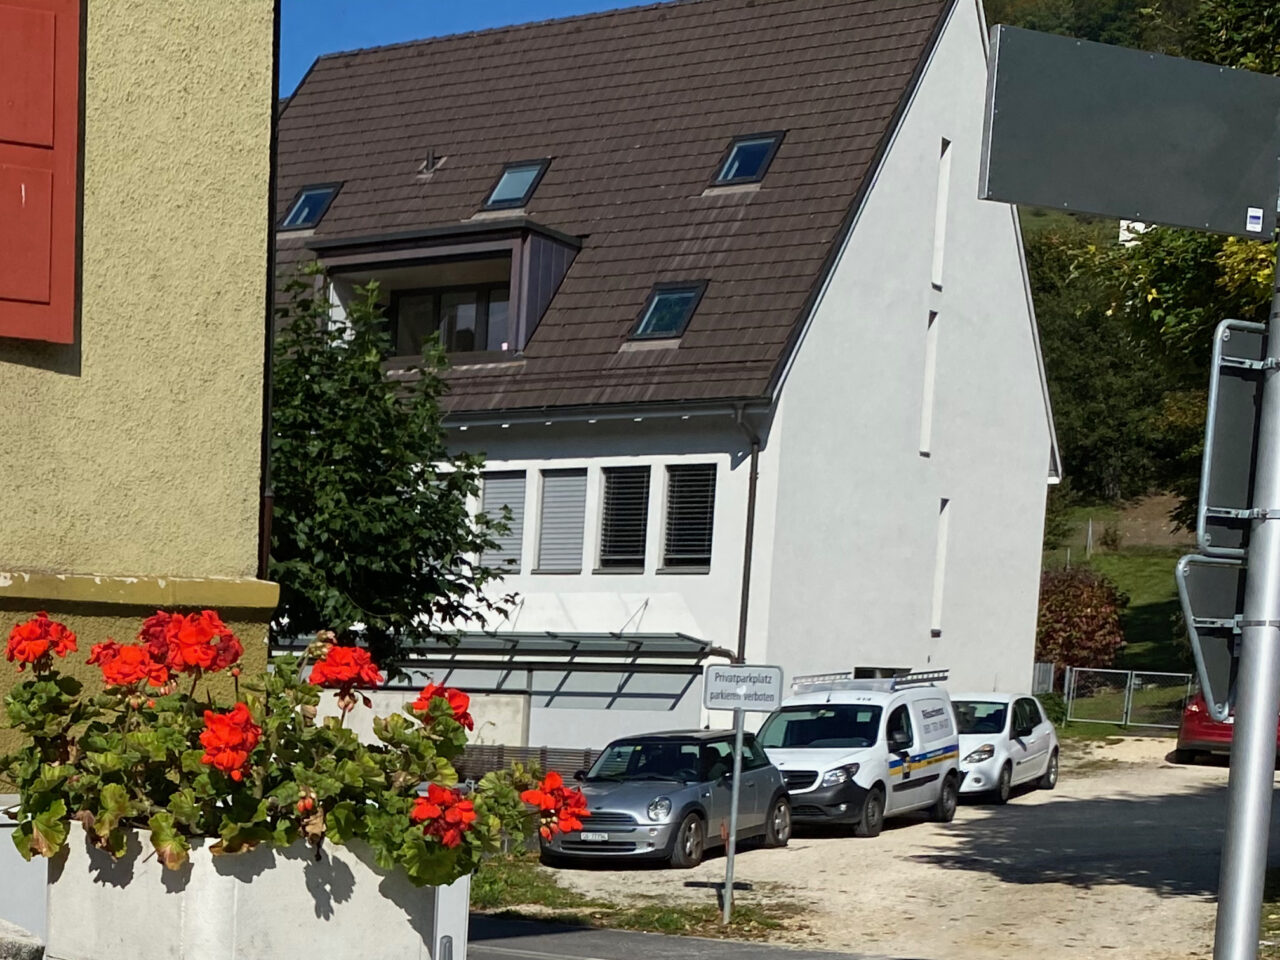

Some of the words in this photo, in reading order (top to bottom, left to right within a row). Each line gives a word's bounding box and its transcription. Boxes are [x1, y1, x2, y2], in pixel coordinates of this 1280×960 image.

[714, 672, 772, 685] Privatparkplatz
[710, 690, 741, 702] parkieren
[743, 691, 774, 702] verboten
